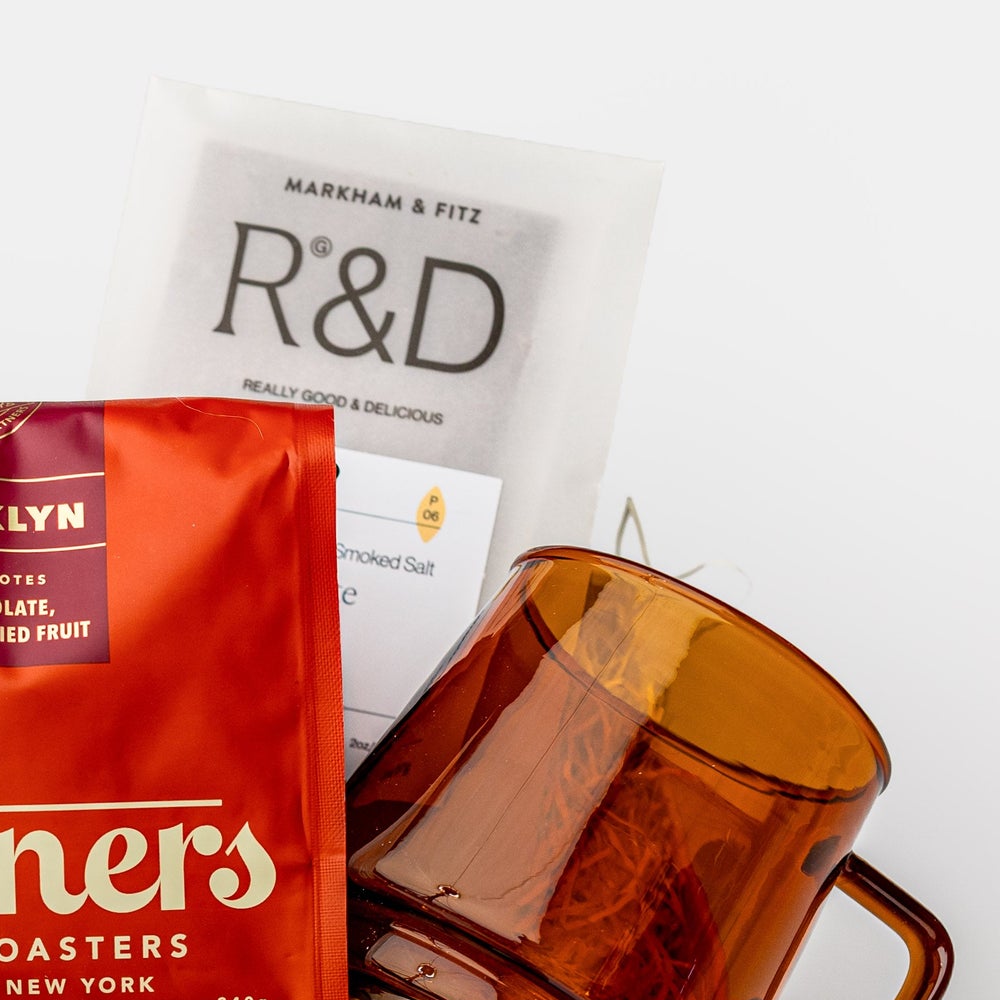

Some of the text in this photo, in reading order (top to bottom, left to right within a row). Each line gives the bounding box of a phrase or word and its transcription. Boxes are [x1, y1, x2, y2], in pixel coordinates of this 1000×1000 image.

[284, 177, 482, 225] MARKHAM & FITZ
[242, 378, 444, 424] REALLY GOOD & DELICIOUS
[429, 495, 439, 506] P
[422, 509, 439, 522] 06
[337, 542, 435, 577] Smoked Salt
[36, 620, 91, 642] FRUIT
[6, 978, 71, 995] NEW
[81, 976, 156, 994] YORK
